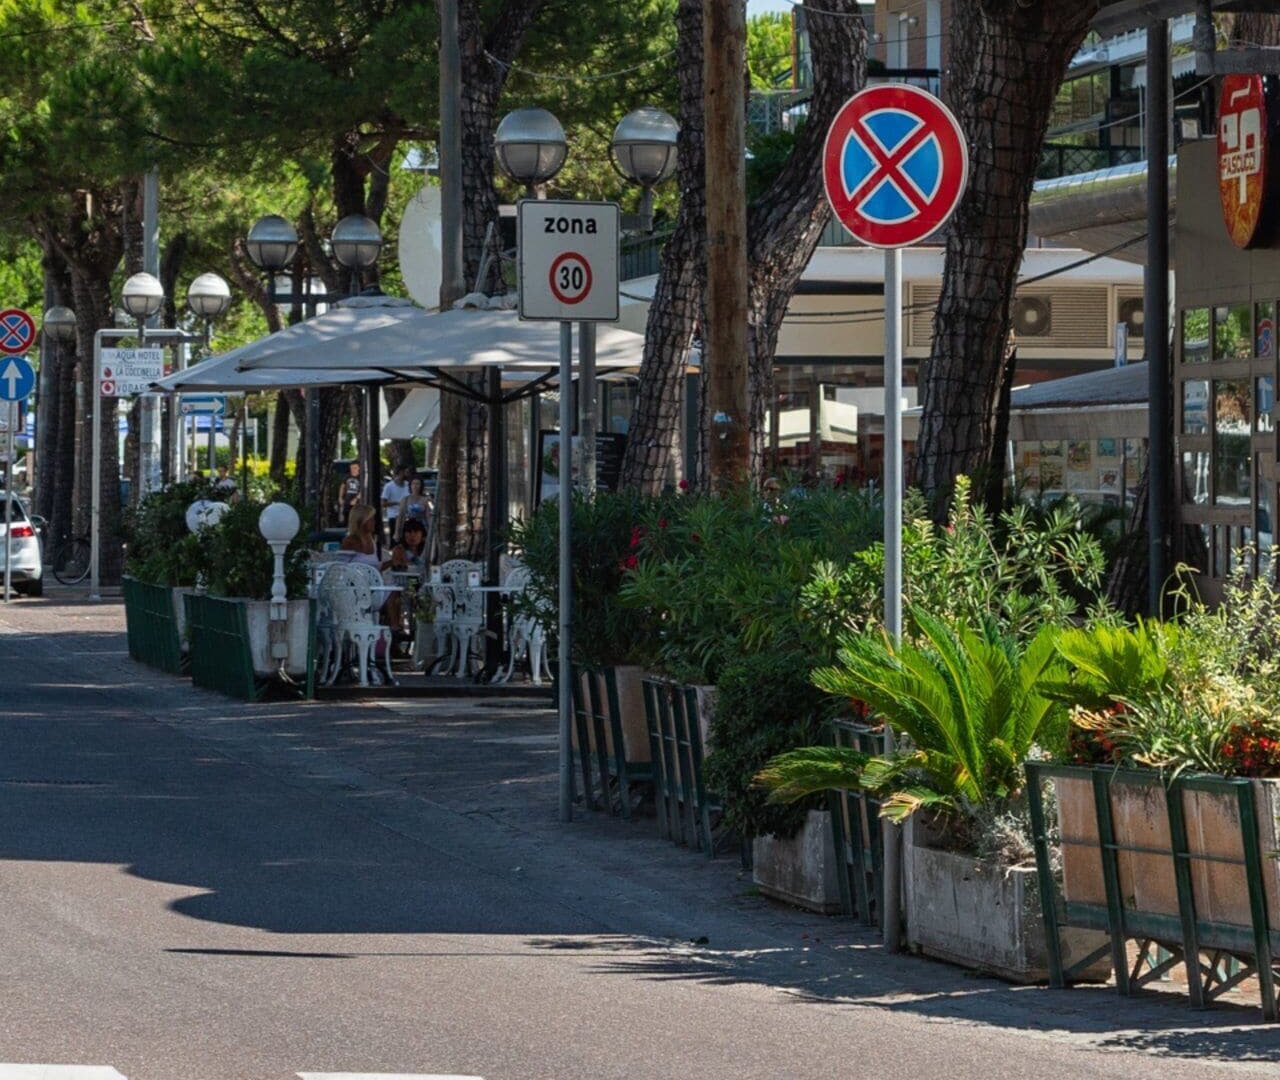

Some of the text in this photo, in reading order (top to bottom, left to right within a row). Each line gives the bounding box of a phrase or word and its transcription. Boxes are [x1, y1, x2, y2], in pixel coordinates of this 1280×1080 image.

[544, 217, 597, 234] zona
[560, 266, 583, 290] 30
[116, 351, 160, 362] AQUA HOTEL
[116, 367, 123, 376] LA
